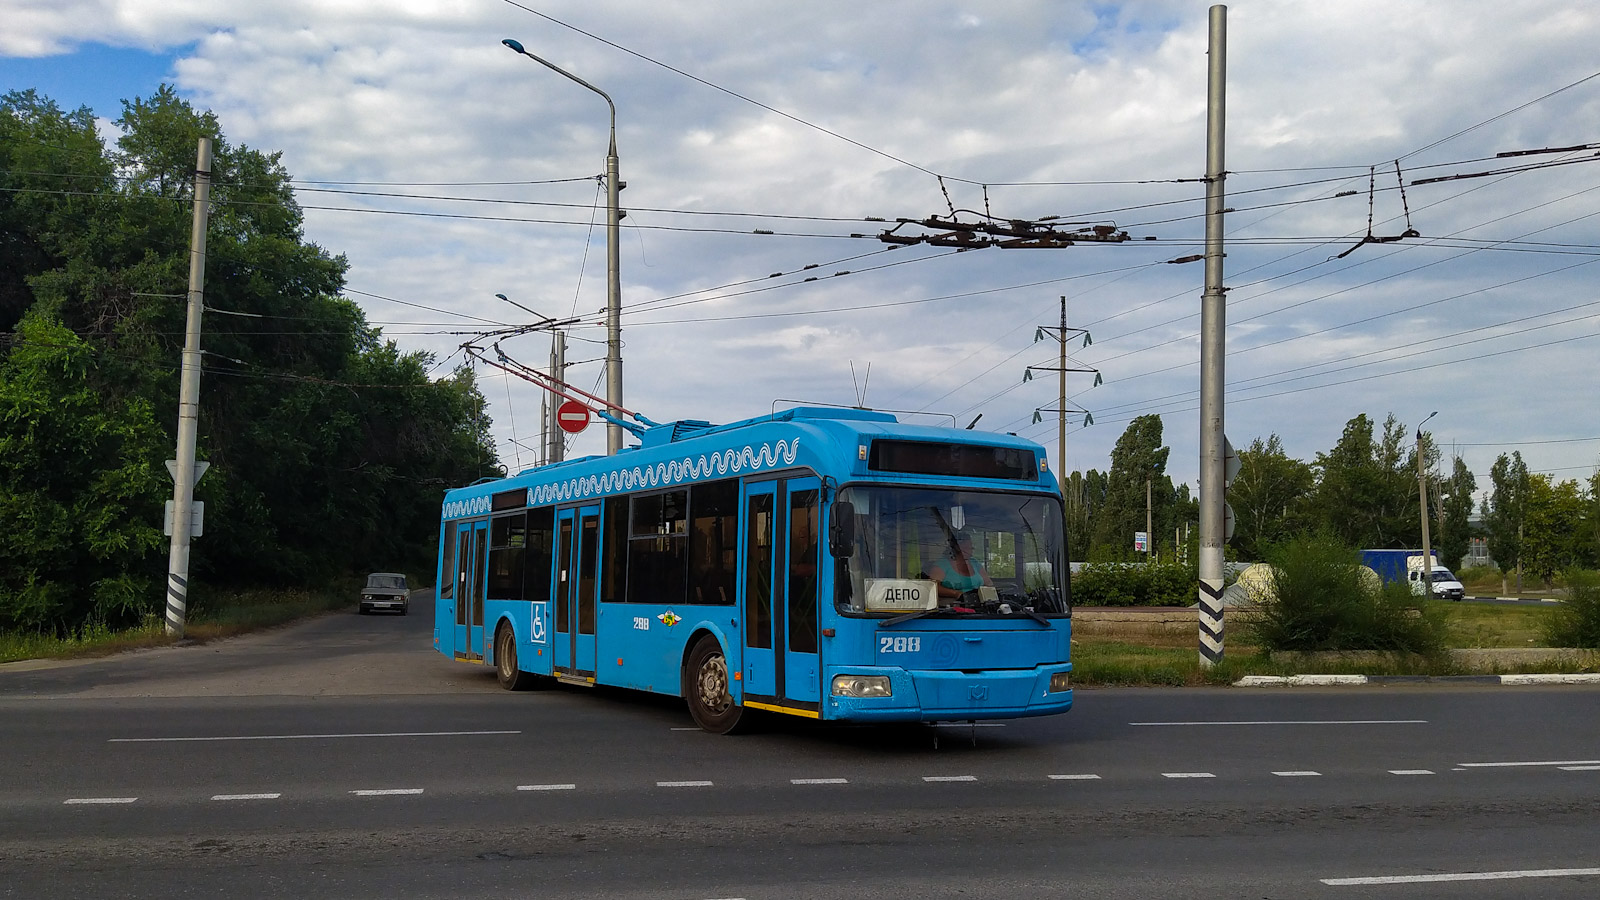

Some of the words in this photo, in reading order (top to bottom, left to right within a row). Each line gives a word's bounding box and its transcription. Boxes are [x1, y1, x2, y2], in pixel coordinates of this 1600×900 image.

[885, 588, 920, 603] ДЕПО
[633, 616, 649, 630] 288
[880, 636, 921, 653] 288
